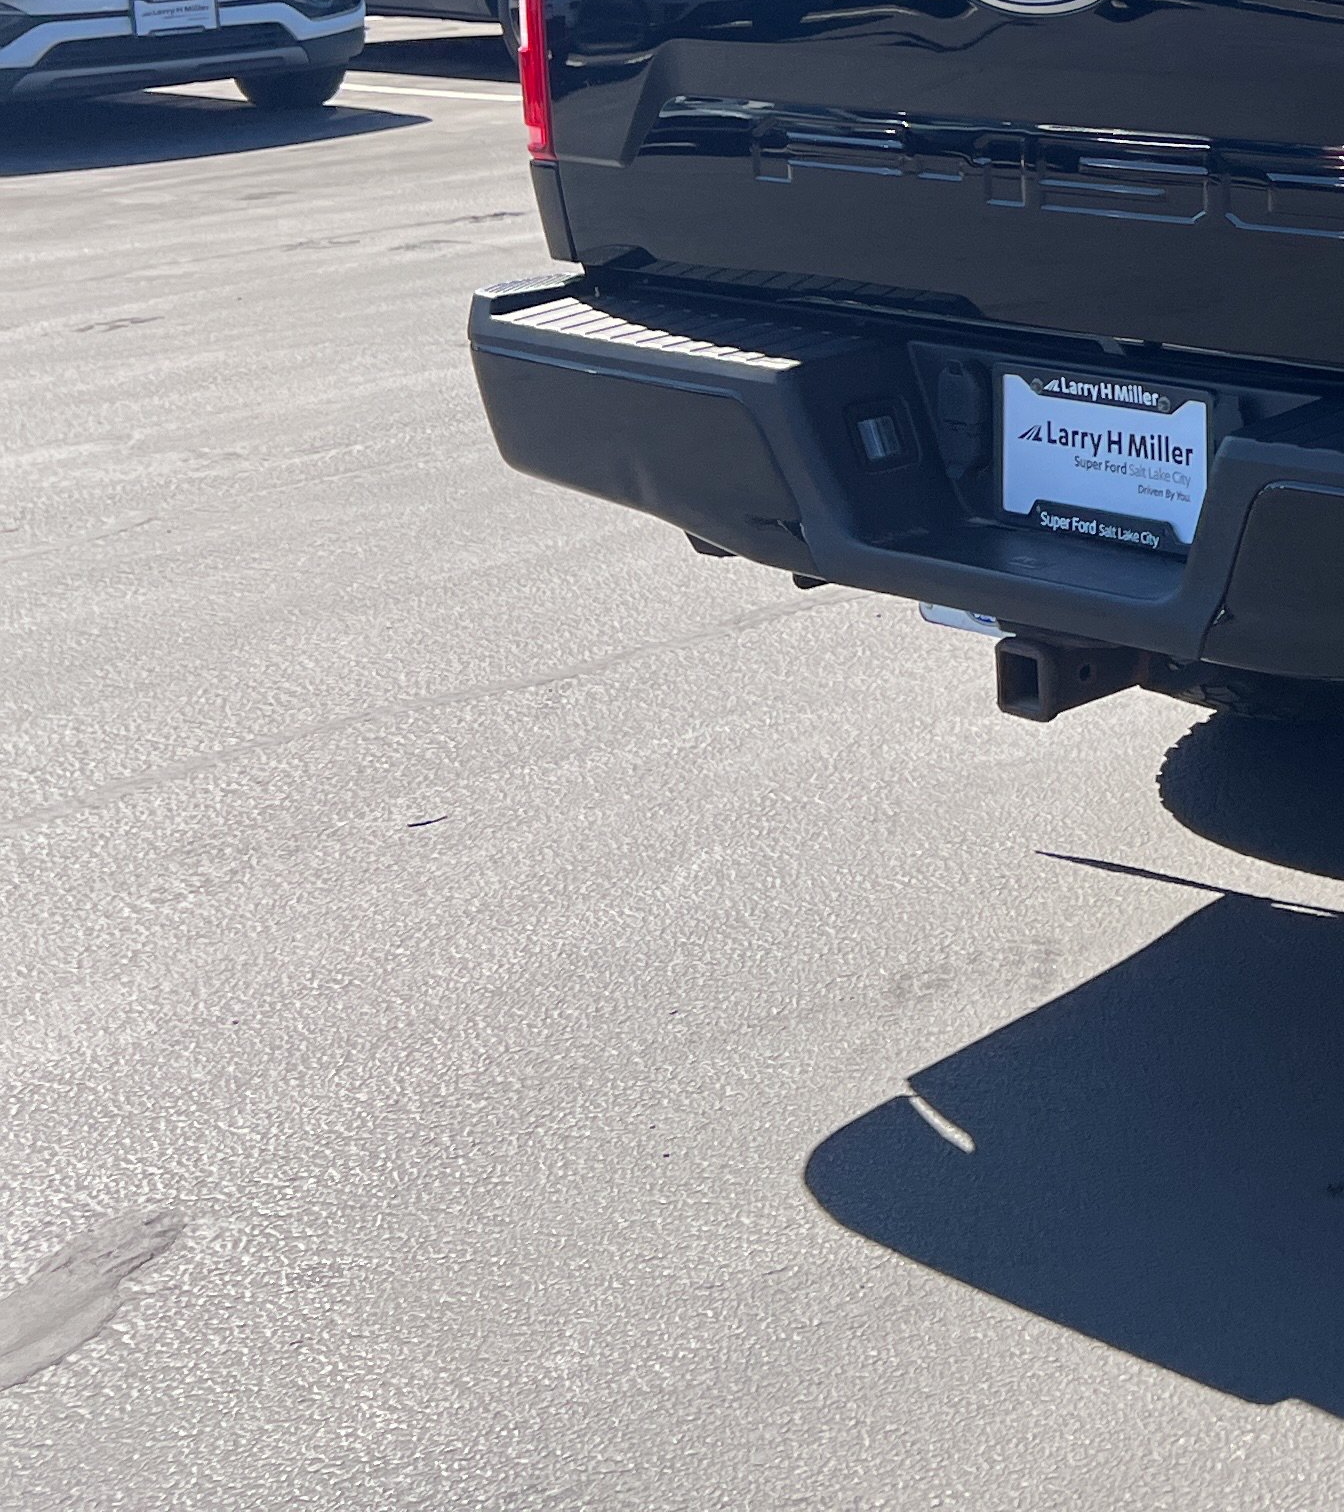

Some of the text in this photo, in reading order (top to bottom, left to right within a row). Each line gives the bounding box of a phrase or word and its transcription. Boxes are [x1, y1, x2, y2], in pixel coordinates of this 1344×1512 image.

[1060, 376, 1160, 407] Larry H Miller
[1046, 420, 1194, 466] Larry H Miller
[1074, 455, 1192, 488] Super Ford Salt Lake City
[1137, 484, 1164, 498] Driven
[1165, 489, 1176, 501] By
[1039, 510, 1160, 549] Super Ford Salt Lake City
